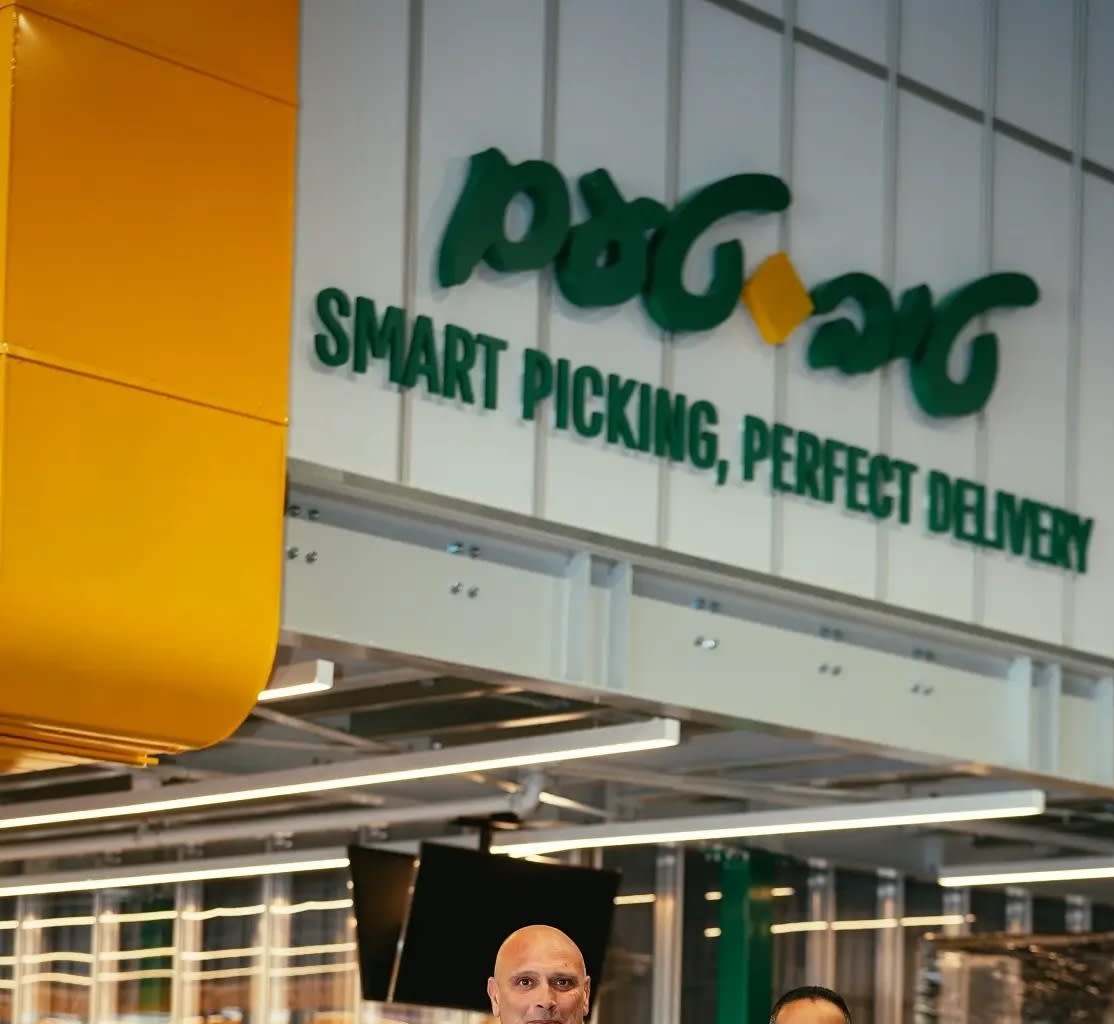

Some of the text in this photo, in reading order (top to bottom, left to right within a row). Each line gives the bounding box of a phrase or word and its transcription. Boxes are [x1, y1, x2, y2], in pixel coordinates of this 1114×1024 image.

[314, 287, 1094, 574] SMART PICKING, PERFECT DELIVERY
